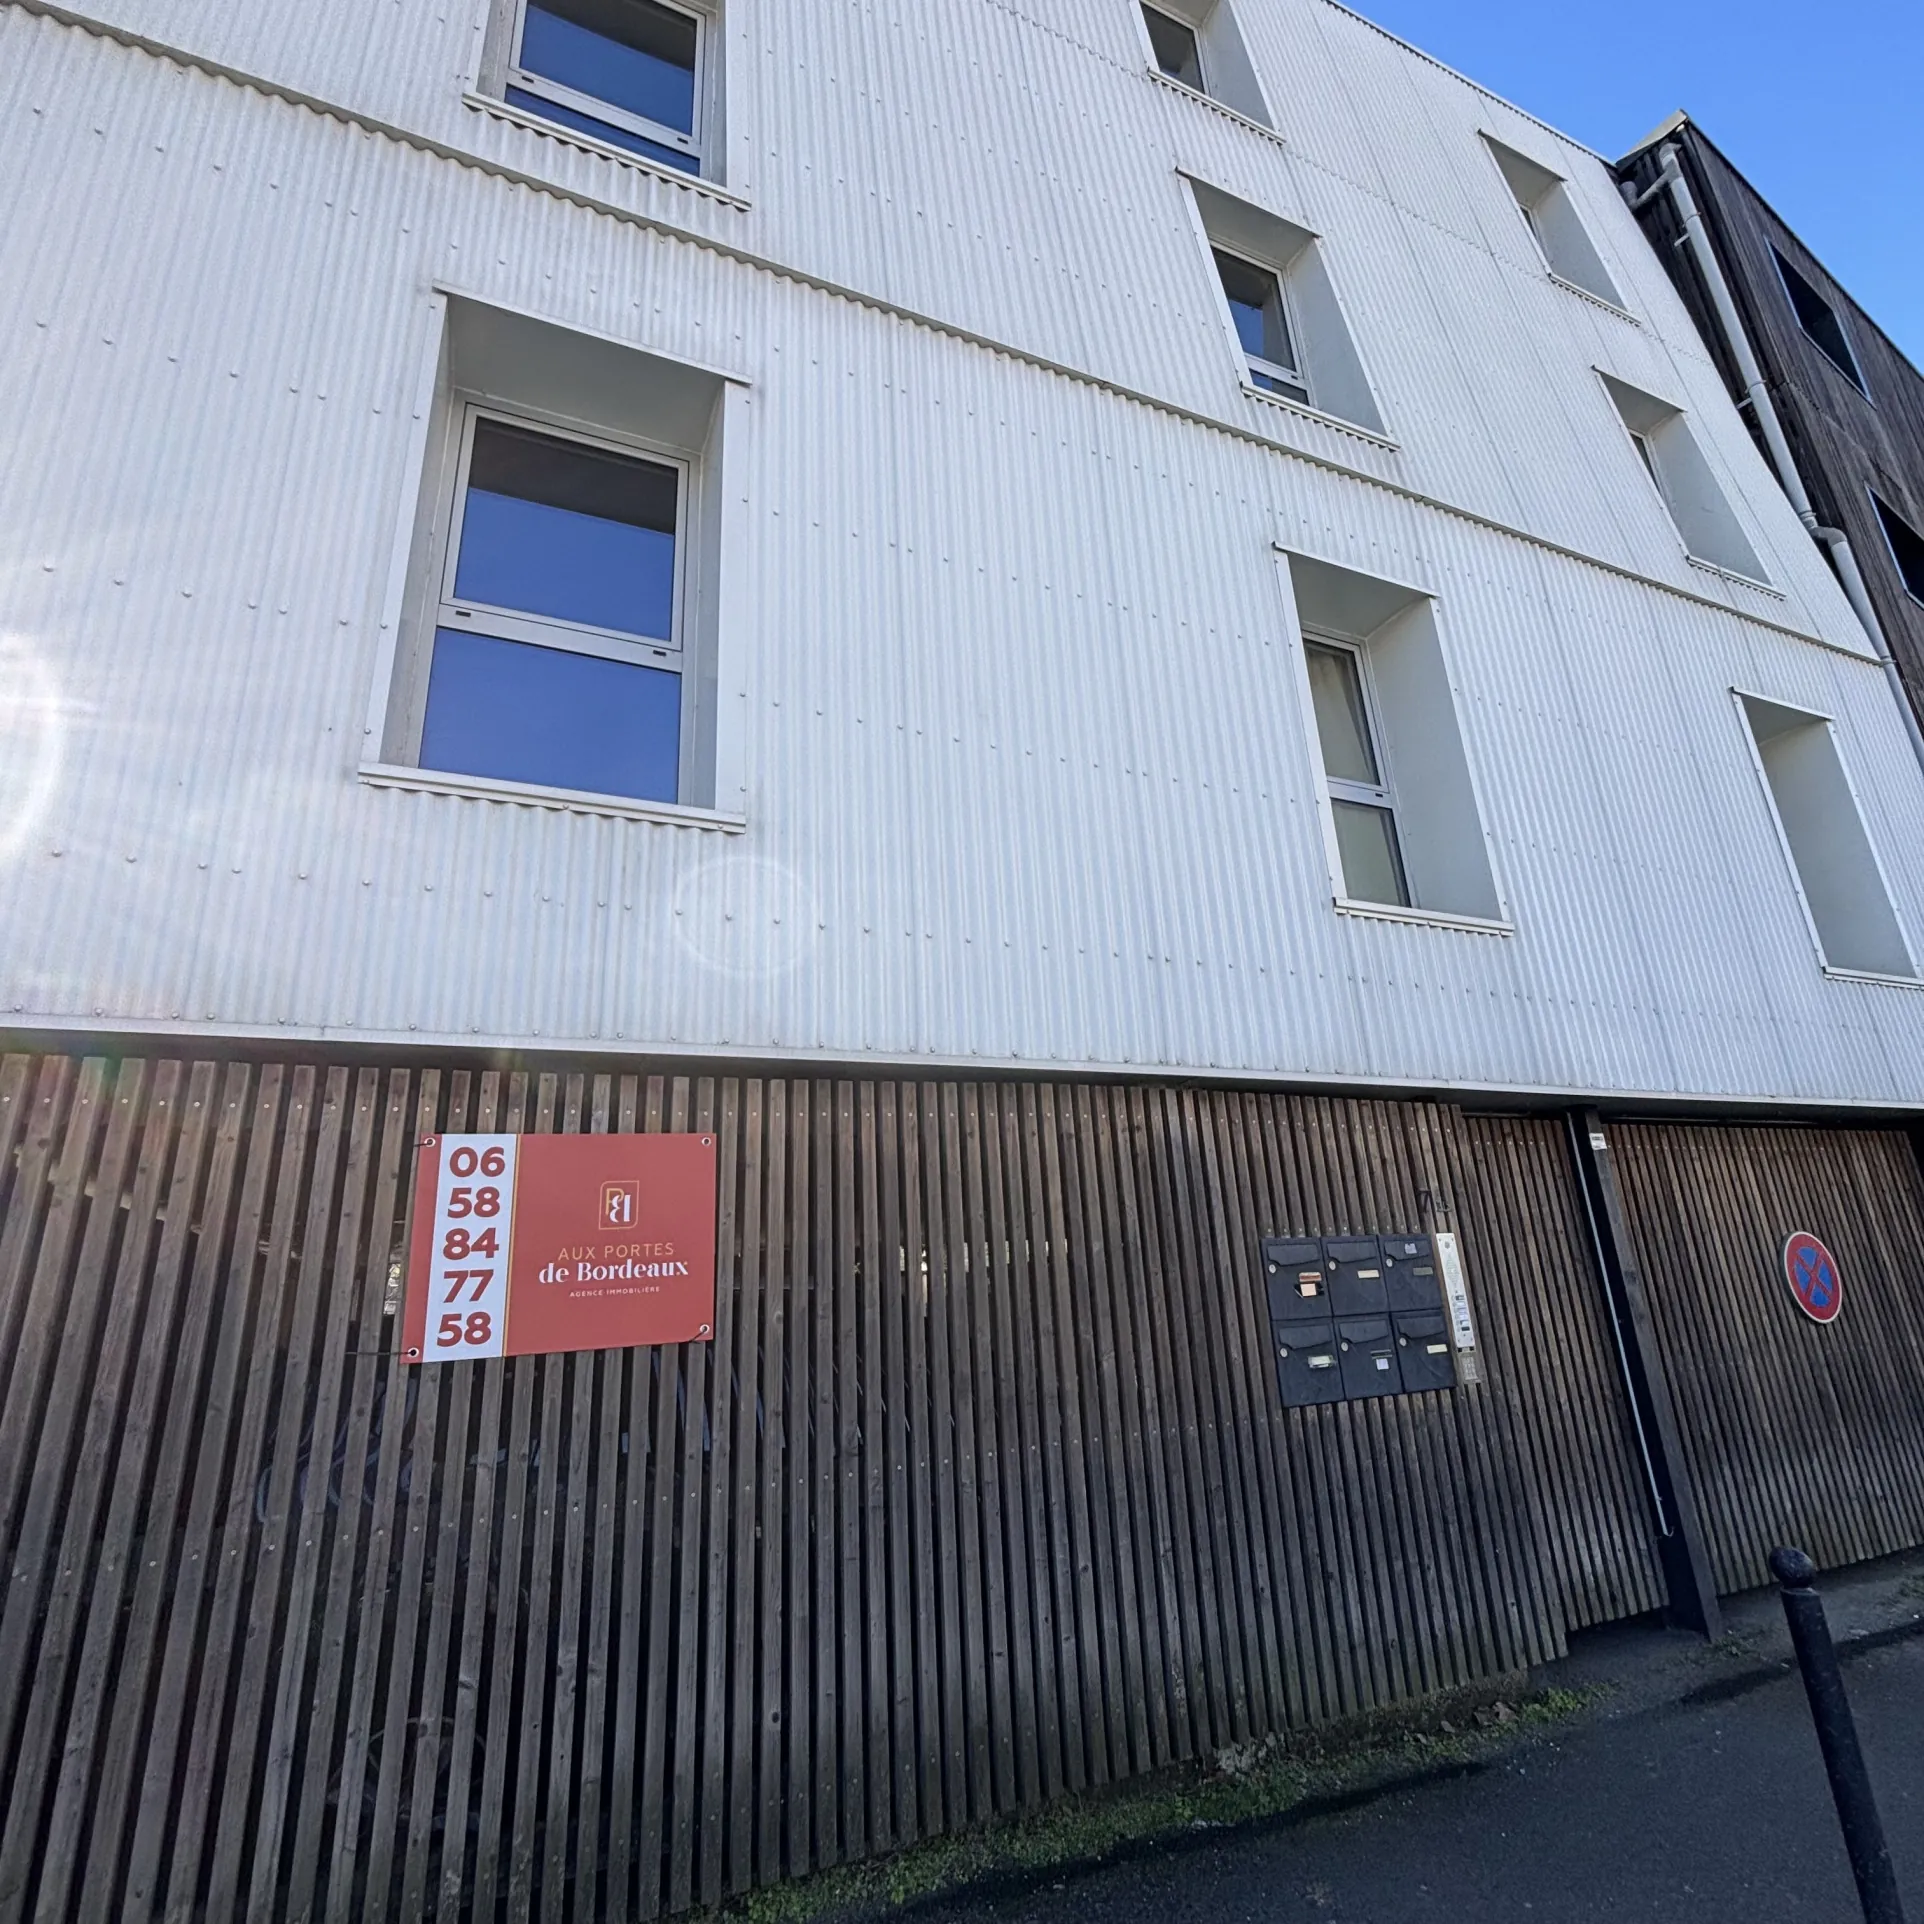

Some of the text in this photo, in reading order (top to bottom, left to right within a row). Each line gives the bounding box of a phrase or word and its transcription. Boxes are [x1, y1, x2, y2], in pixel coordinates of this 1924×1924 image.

[450, 1147, 505, 1177] 06
[448, 1187, 500, 1218] 58
[443, 1228, 499, 1260] 84
[558, 1243, 674, 1261] AUX PORTES
[443, 1269, 494, 1303] 77
[538, 1258, 689, 1284] de Bordeaux
[569, 1289, 603, 1298] AGENCE
[436, 1312, 492, 1347] 58
